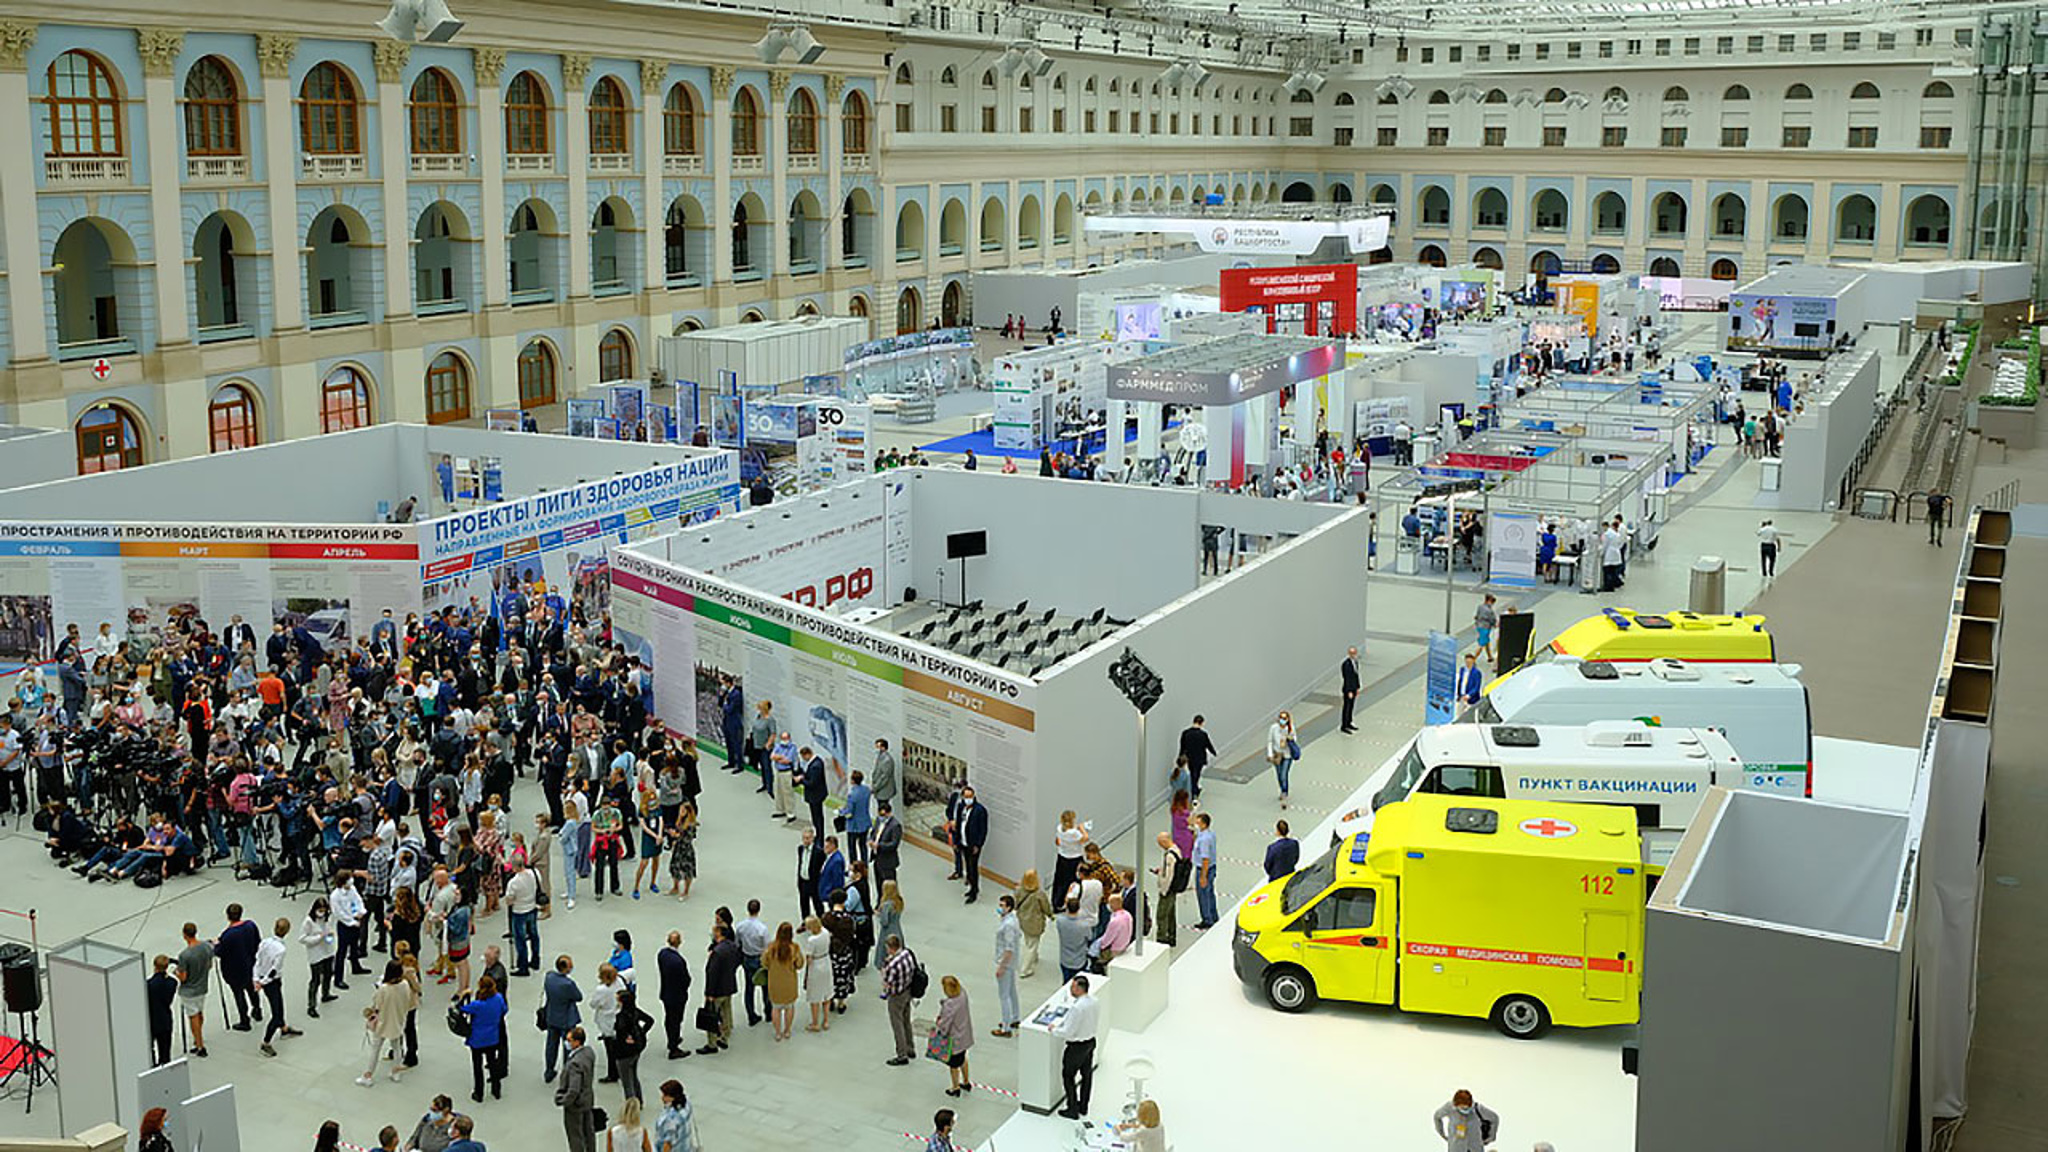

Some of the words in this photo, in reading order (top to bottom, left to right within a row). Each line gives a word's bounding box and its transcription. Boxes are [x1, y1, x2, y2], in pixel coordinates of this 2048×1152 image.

[1115, 376, 1209, 394] ФАРММЕДПРОМ
[748, 412, 773, 432] 30
[817, 407, 844, 425] 30
[435, 501, 530, 541] ПРОЕКТЫ
[534, 489, 582, 518] ЛИГИ
[586, 467, 673, 504] ЗДОРОВЬЯ
[677, 454, 729, 482] НАЦИИ
[434, 525, 521, 556] НАПРАВЛЕННЫЕ
[523, 522, 537, 535] НА
[538, 500, 613, 530] ФОРМИРОВАНИЕ
[616, 490, 667, 512] ЗДОРОВОГО
[668, 482, 700, 496] ОБРАЗА
[702, 473, 729, 487] ЖИЗНИ
[2, 526, 110, 538] ПРОСТРАНЕНИЯ
[113, 526, 123, 538] И
[127, 525, 264, 539] ПРОТИВОДЕЙСТВИЯ
[267, 528, 286, 539] НА
[291, 528, 380, 540] ТЕРРИТОРИИ
[382, 528, 404, 541] РФ
[19, 544, 73, 555] ФЕВРАЛЬ
[178, 546, 210, 556] МАРТ
[322, 546, 368, 558] АПРЕЛЬ
[642, 583, 658, 596] МАЙ
[728, 614, 753, 630] ИЮНЬ
[655, 567, 696, 594] ХРОНИКА
[695, 580, 785, 619] РАСПРОСТРАНЕНИЯ
[786, 612, 795, 623] И
[796, 613, 902, 659] ПРОТИВОДЕЙСТВИЯ
[902, 648, 919, 666] НА
[920, 654, 999, 693] ТЕРРИТОРИИ
[999, 682, 1020, 698] РФ
[831, 649, 858, 668] ИЮЛЬ
[946, 689, 987, 712] АВГУСТ
[1519, 777, 1574, 791] ПУНКТ
[1578, 779, 1698, 794] ВАКЦИНАЦИИ
[1580, 874, 1615, 896] 112
[1409, 943, 1449, 956] СКОРАЯ
[1456, 948, 1529, 963] МЕДИЦИНСКАЯ
[1536, 954, 1584, 968] ПОМОЩЬ
